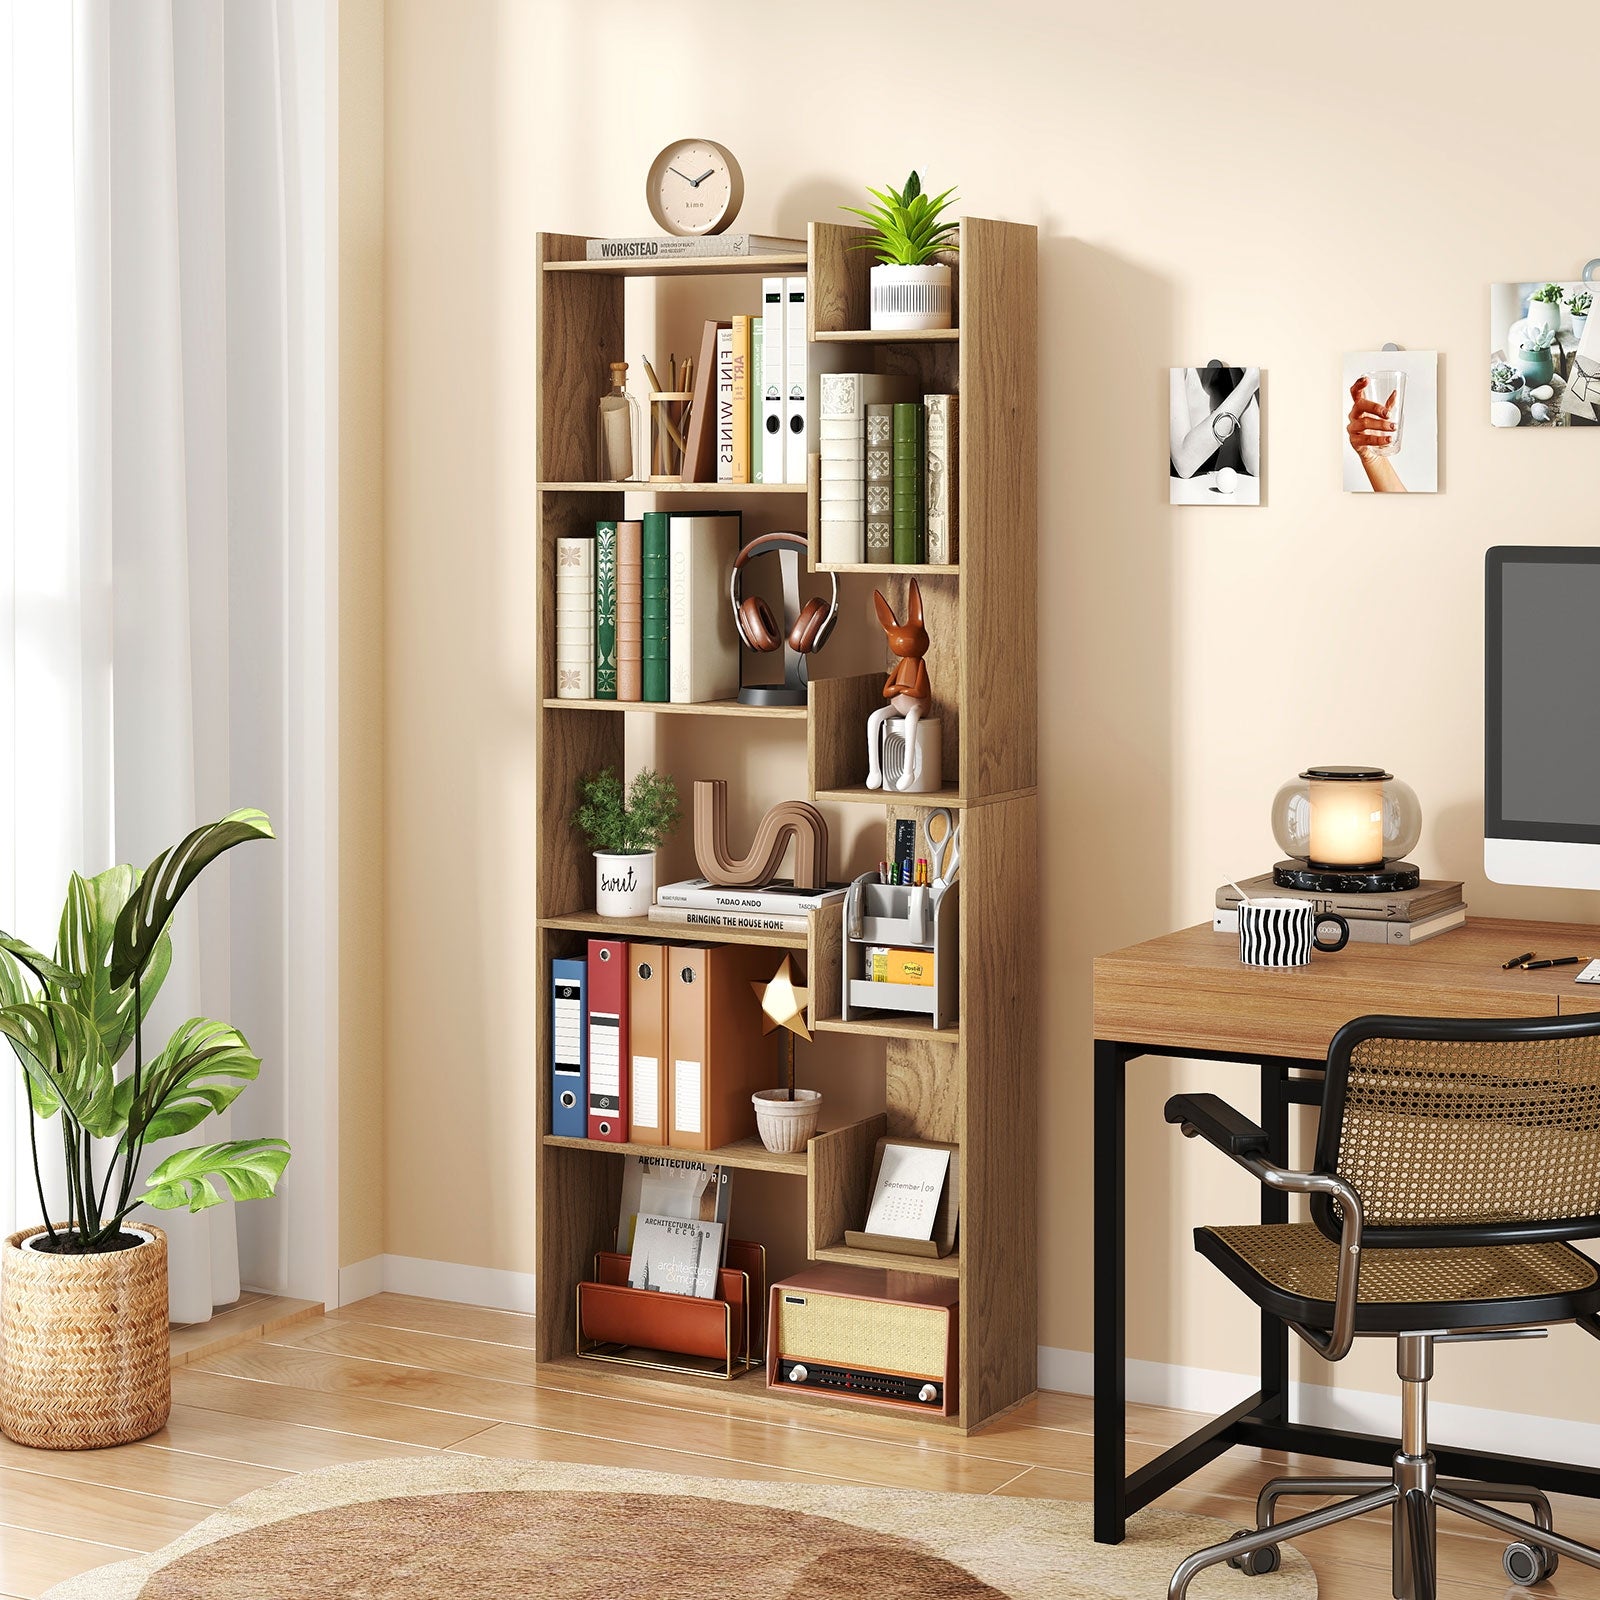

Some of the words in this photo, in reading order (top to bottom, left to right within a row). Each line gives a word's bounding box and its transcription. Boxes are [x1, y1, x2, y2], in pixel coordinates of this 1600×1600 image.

[601, 242, 658, 257] WORKSTEAD
[674, 551, 685, 625] LUXDECO
[716, 897, 740, 906] TADAO
[741, 900, 762, 908] ANDO
[686, 914, 721, 925] BRINGING
[722, 916, 737, 927] THE
[738, 918, 762, 928] HOUSE
[763, 920, 784, 930] HOME
[638, 1155, 707, 1172] ARCHITECTURAL
[884, 1180, 920, 1191] September
[924, 1185, 935, 1193] 09
[644, 1218, 695, 1231] ARCHITECTURAL
